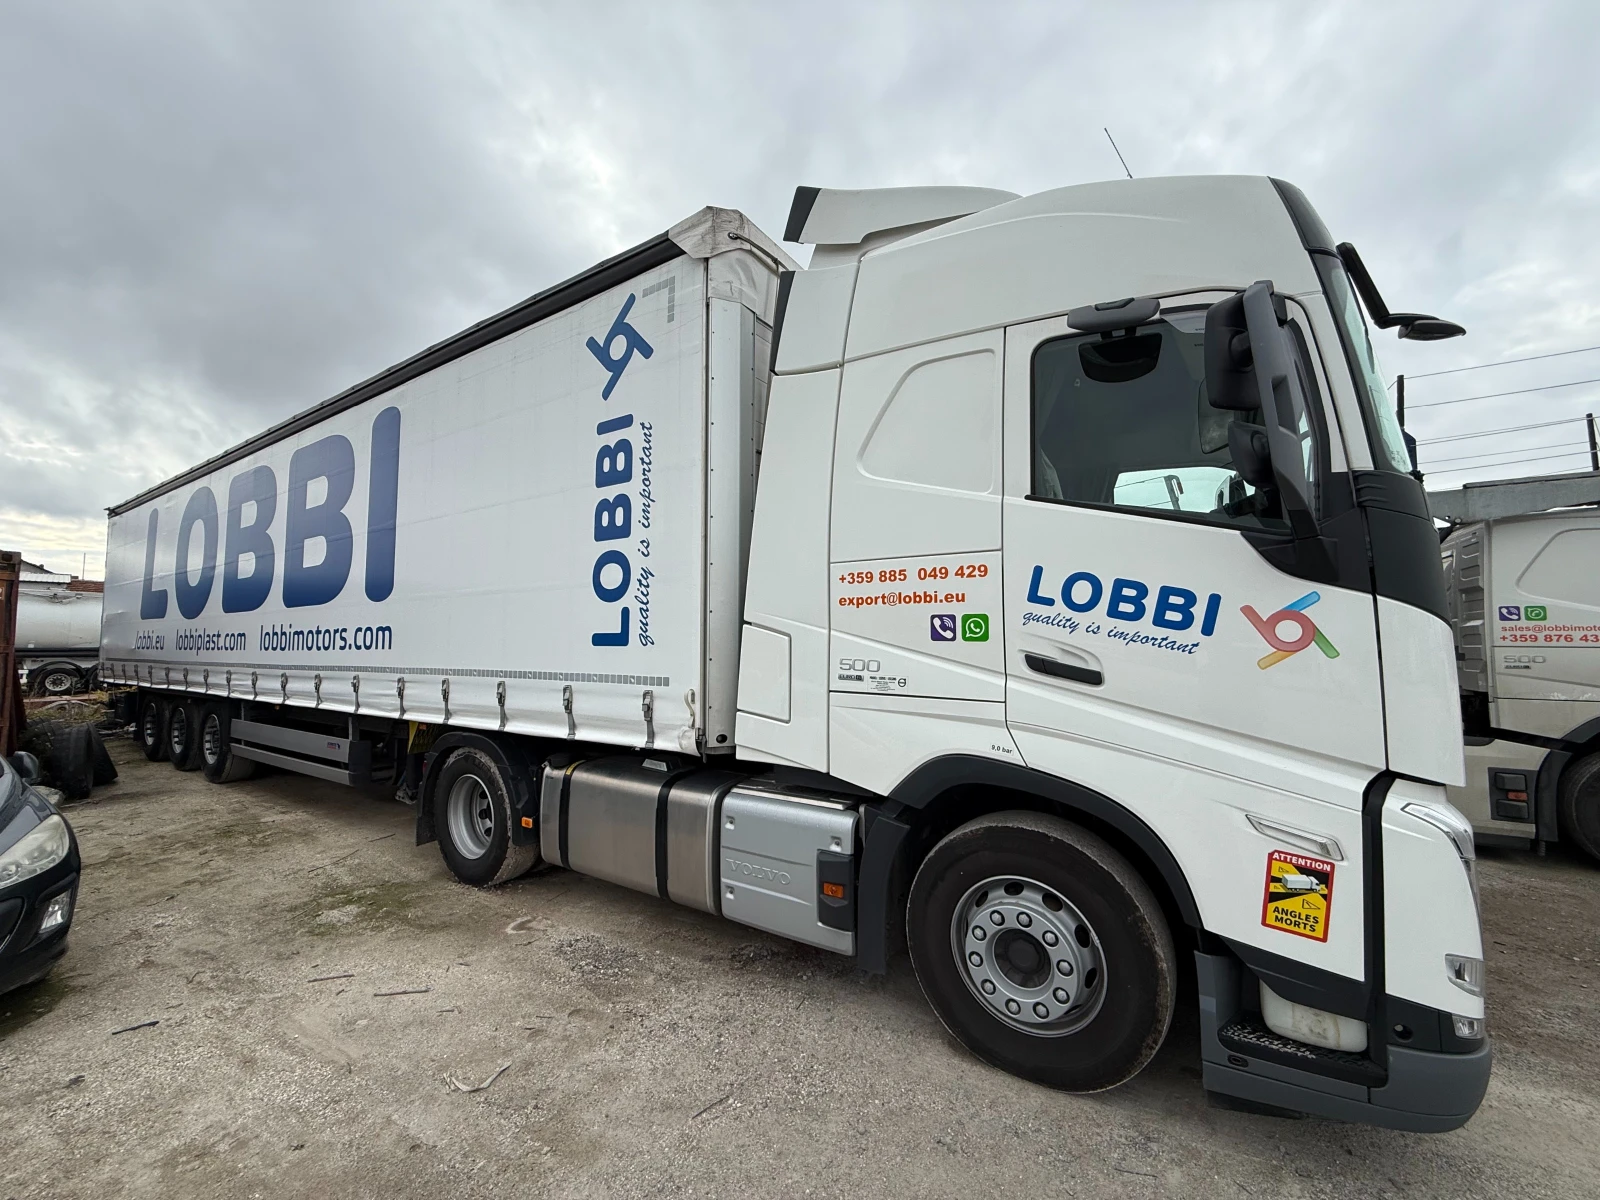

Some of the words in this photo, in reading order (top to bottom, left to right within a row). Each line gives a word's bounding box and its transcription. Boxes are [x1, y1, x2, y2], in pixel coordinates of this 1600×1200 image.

[638, 421, 656, 529] important
[140, 406, 401, 620] LOBBI
[591, 413, 634, 647] LOBBI
[638, 537, 651, 558] is
[838, 571, 874, 585] +359
[878, 569, 908, 583] 885
[917, 566, 949, 581] 049
[954, 564, 989, 579] 429
[634, 565, 655, 646] quality
[838, 590, 966, 609] export@lobbi.eu
[1026, 564, 1222, 637] LOBBI
[134, 630, 165, 650] lobbi.eu
[175, 627, 247, 656] lobbiplast.com
[259, 623, 393, 652] lobbimotors.com
[1022, 611, 1081, 634] quality
[1085, 621, 1101, 635] is
[1107, 626, 1200, 654] important
[1500, 634, 1539, 643] +359
[1543, 633, 1574, 643] 876
[839, 658, 881, 673] 500
[726, 858, 791, 885] VOLVO
[1272, 852, 1331, 872] ATTENTION
[1272, 906, 1319, 924] ANGLES
[1274, 914, 1316, 933] MORTS
